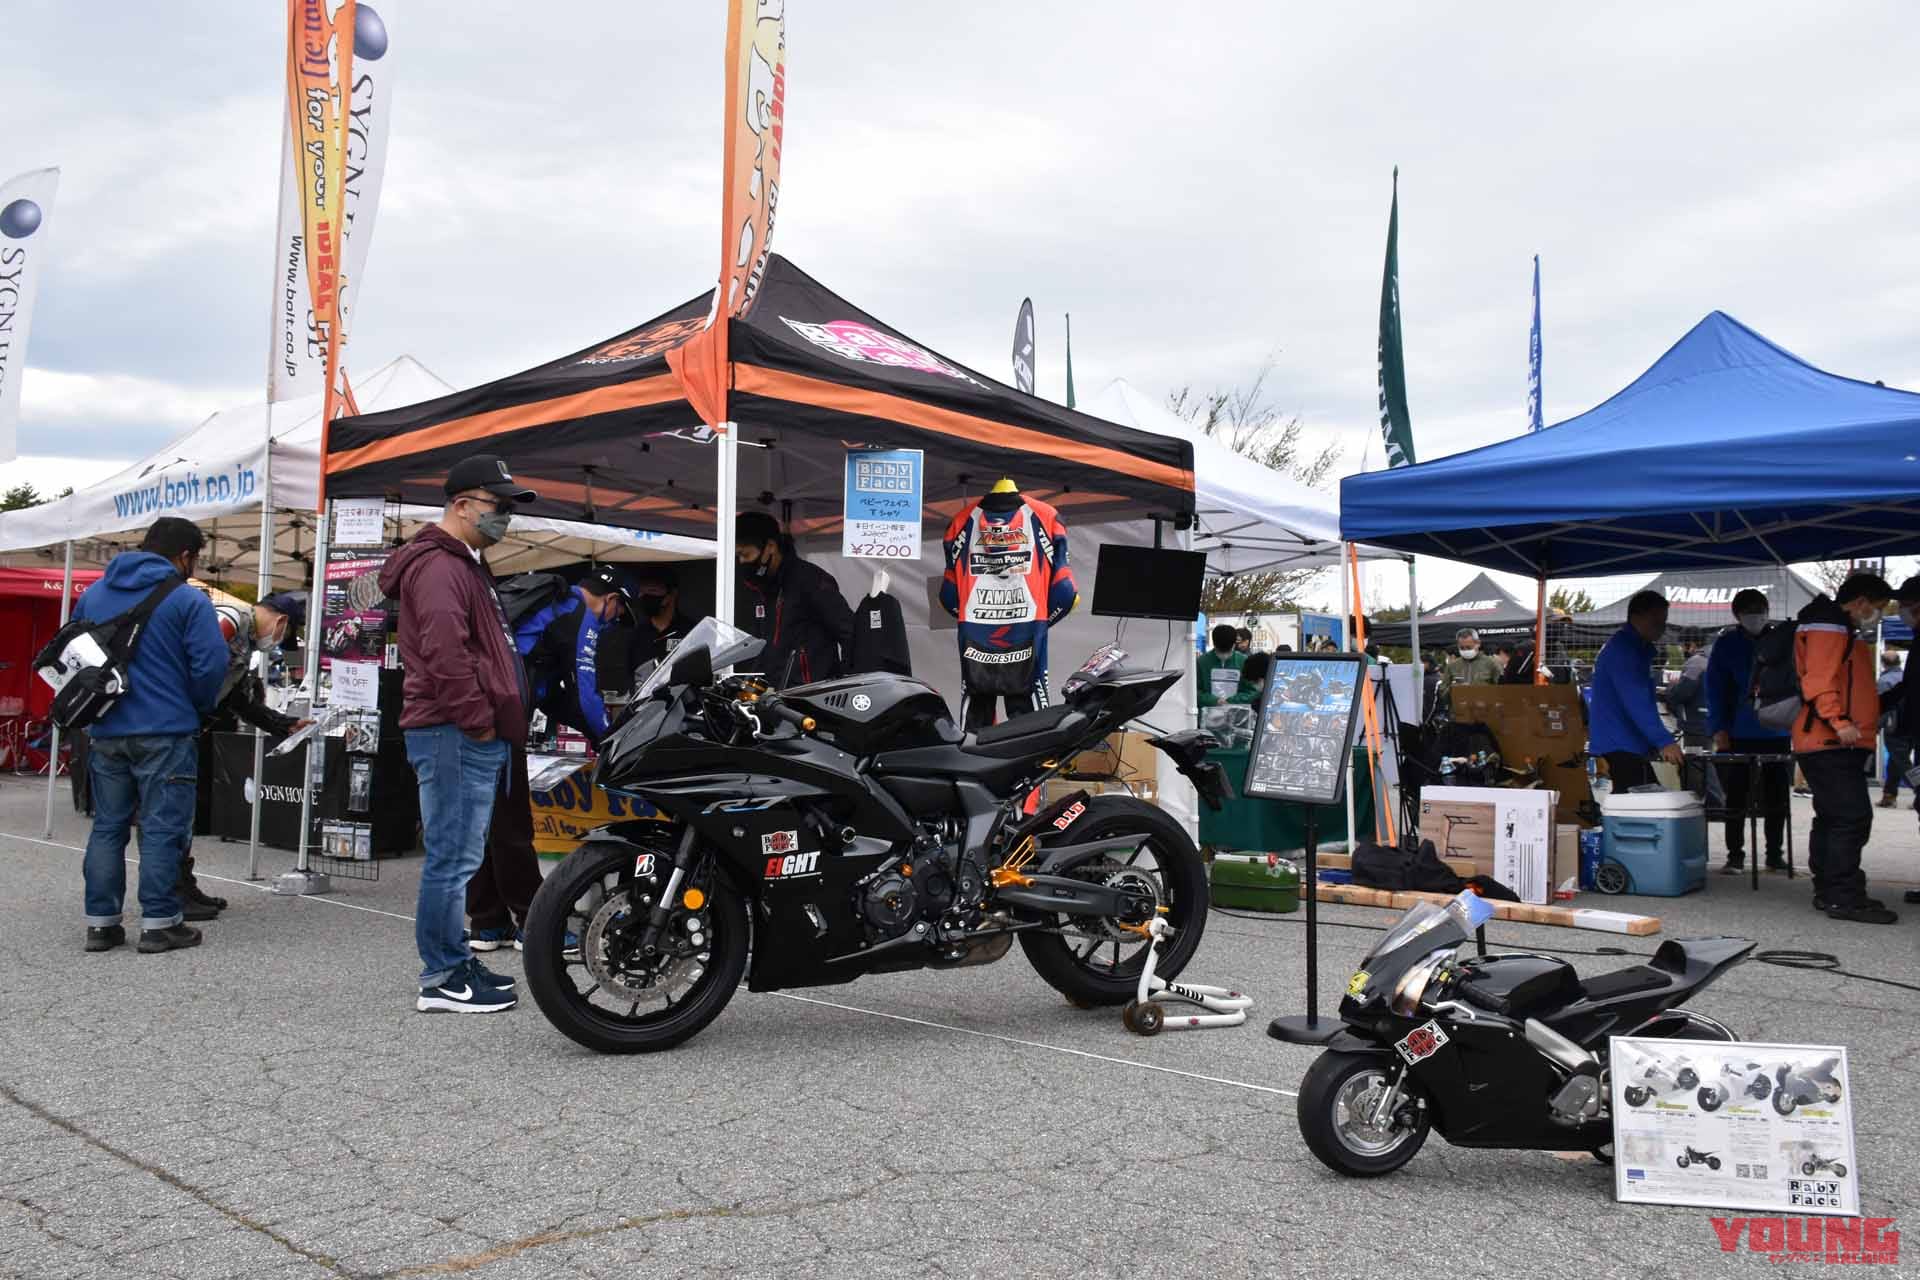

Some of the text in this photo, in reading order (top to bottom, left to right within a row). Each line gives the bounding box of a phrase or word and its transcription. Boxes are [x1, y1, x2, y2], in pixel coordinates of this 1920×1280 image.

[305, 87, 329, 133] for
[306, 139, 326, 211] your
[315, 221, 334, 311] IDEAL
[285, 235, 304, 377] www.bolt.co.jp
[860, 463, 909, 475] Baby
[113, 463, 256, 518] www.bolt.co.jp
[860, 477, 907, 488] Face
[1664, 584, 1770, 603] YAMALE
[973, 606, 1029, 620] TAICHI
[963, 646, 1034, 664] BRIDGESTONE
[764, 850, 821, 878] EIGHT
[1789, 1180, 1839, 1194] Baby
[1790, 1193, 1840, 1207] Face
